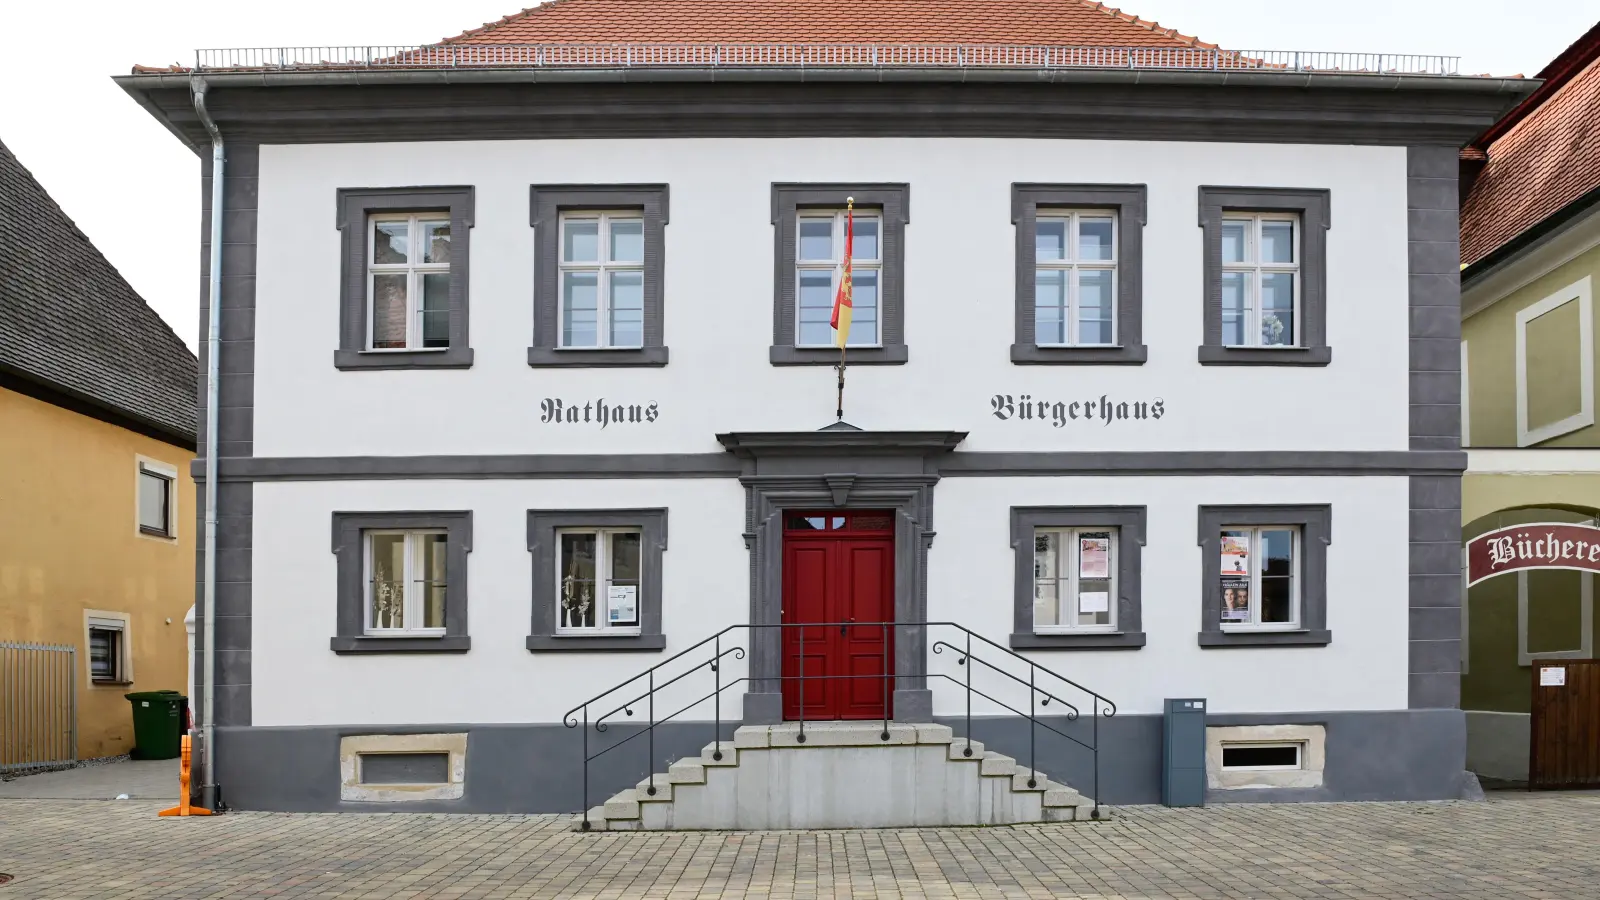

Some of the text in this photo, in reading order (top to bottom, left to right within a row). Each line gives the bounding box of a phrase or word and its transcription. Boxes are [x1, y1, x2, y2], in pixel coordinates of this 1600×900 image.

[540, 397, 659, 430] Rathaus
[990, 393, 1165, 428] Bürgerhaus
[1487, 532, 1600, 570] Büchere
